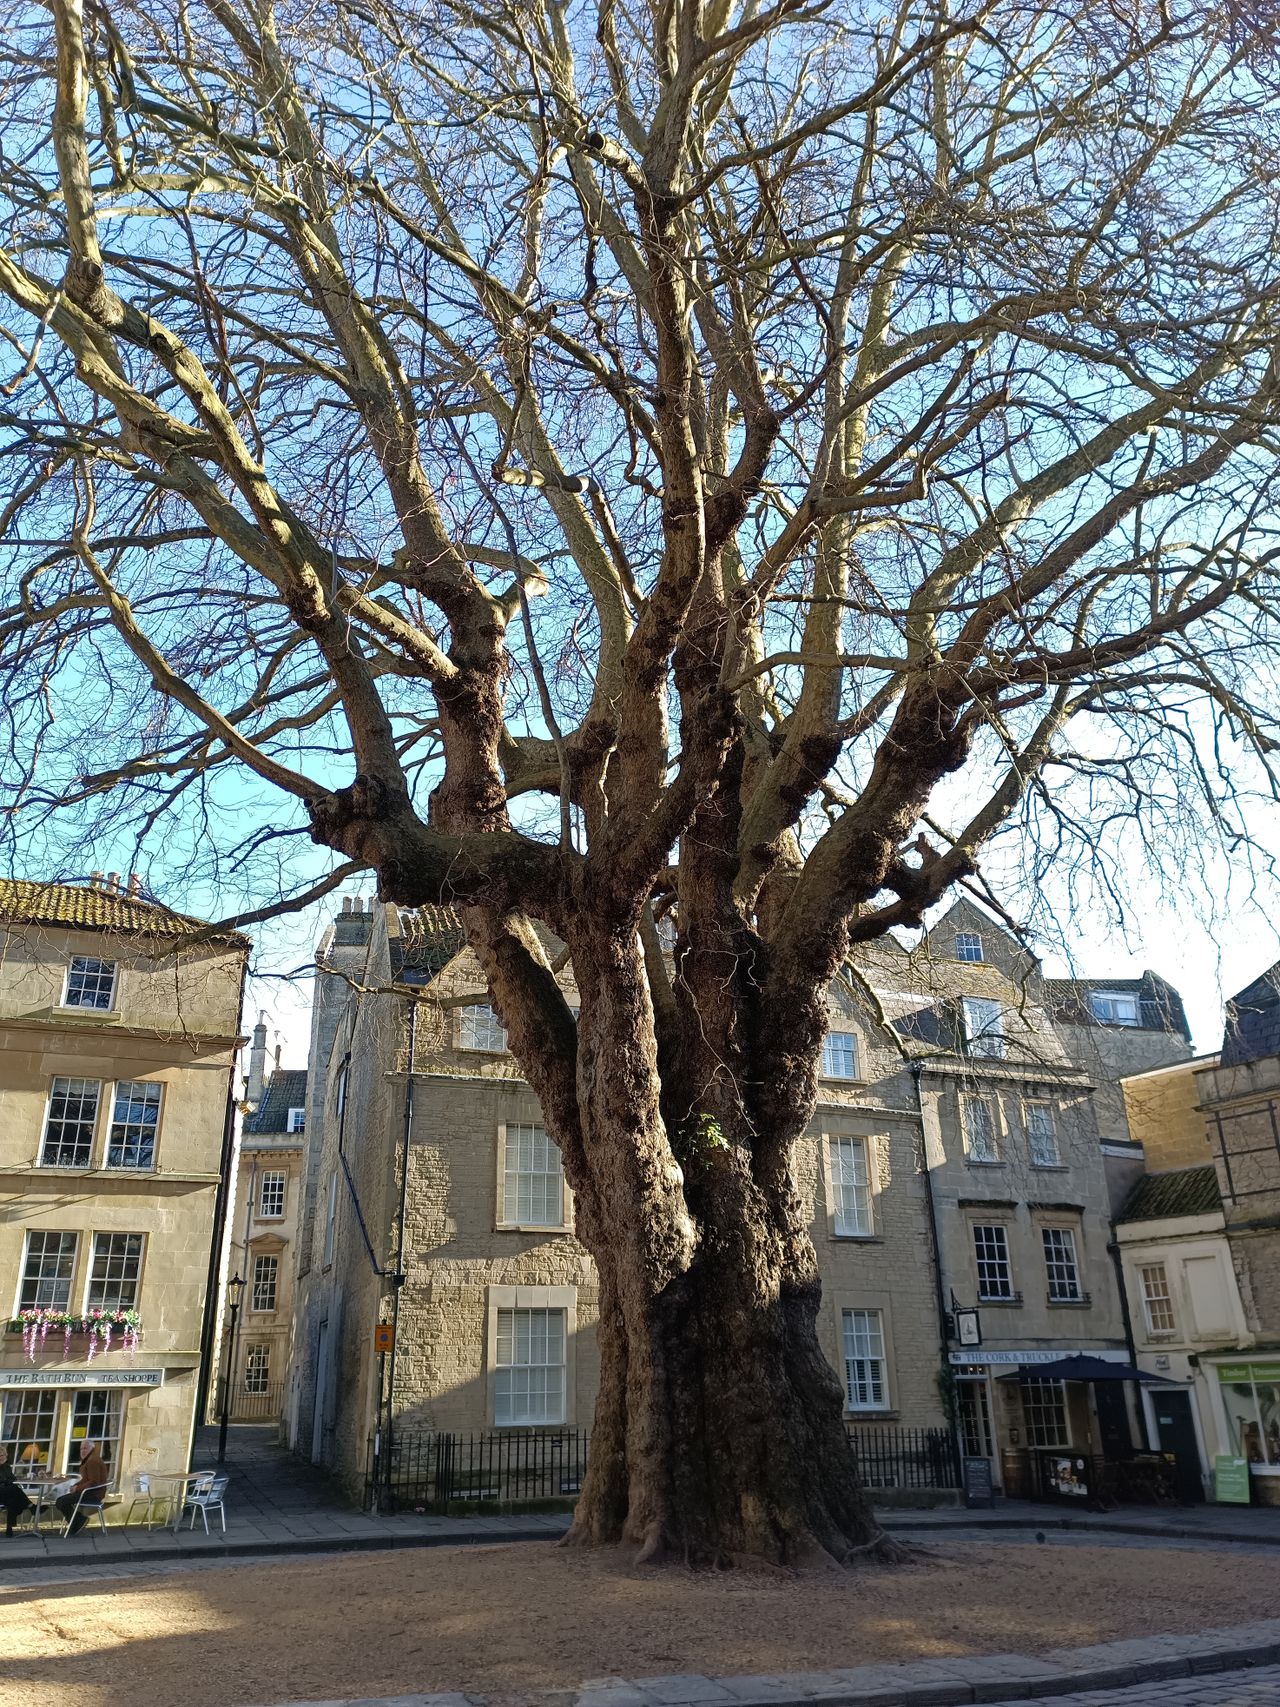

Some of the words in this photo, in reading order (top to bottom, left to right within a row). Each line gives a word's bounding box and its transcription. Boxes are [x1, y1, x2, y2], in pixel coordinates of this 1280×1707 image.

[965, 1353, 984, 1362] THE
[985, 1353, 1011, 1362] CORK
[6, 1374, 29, 1384] THE
[31, 1373, 62, 1384] BATH
[64, 1373, 88, 1383] BUN
[102, 1374, 121, 1383] TEA
[122, 1374, 159, 1383] SHOPPE
